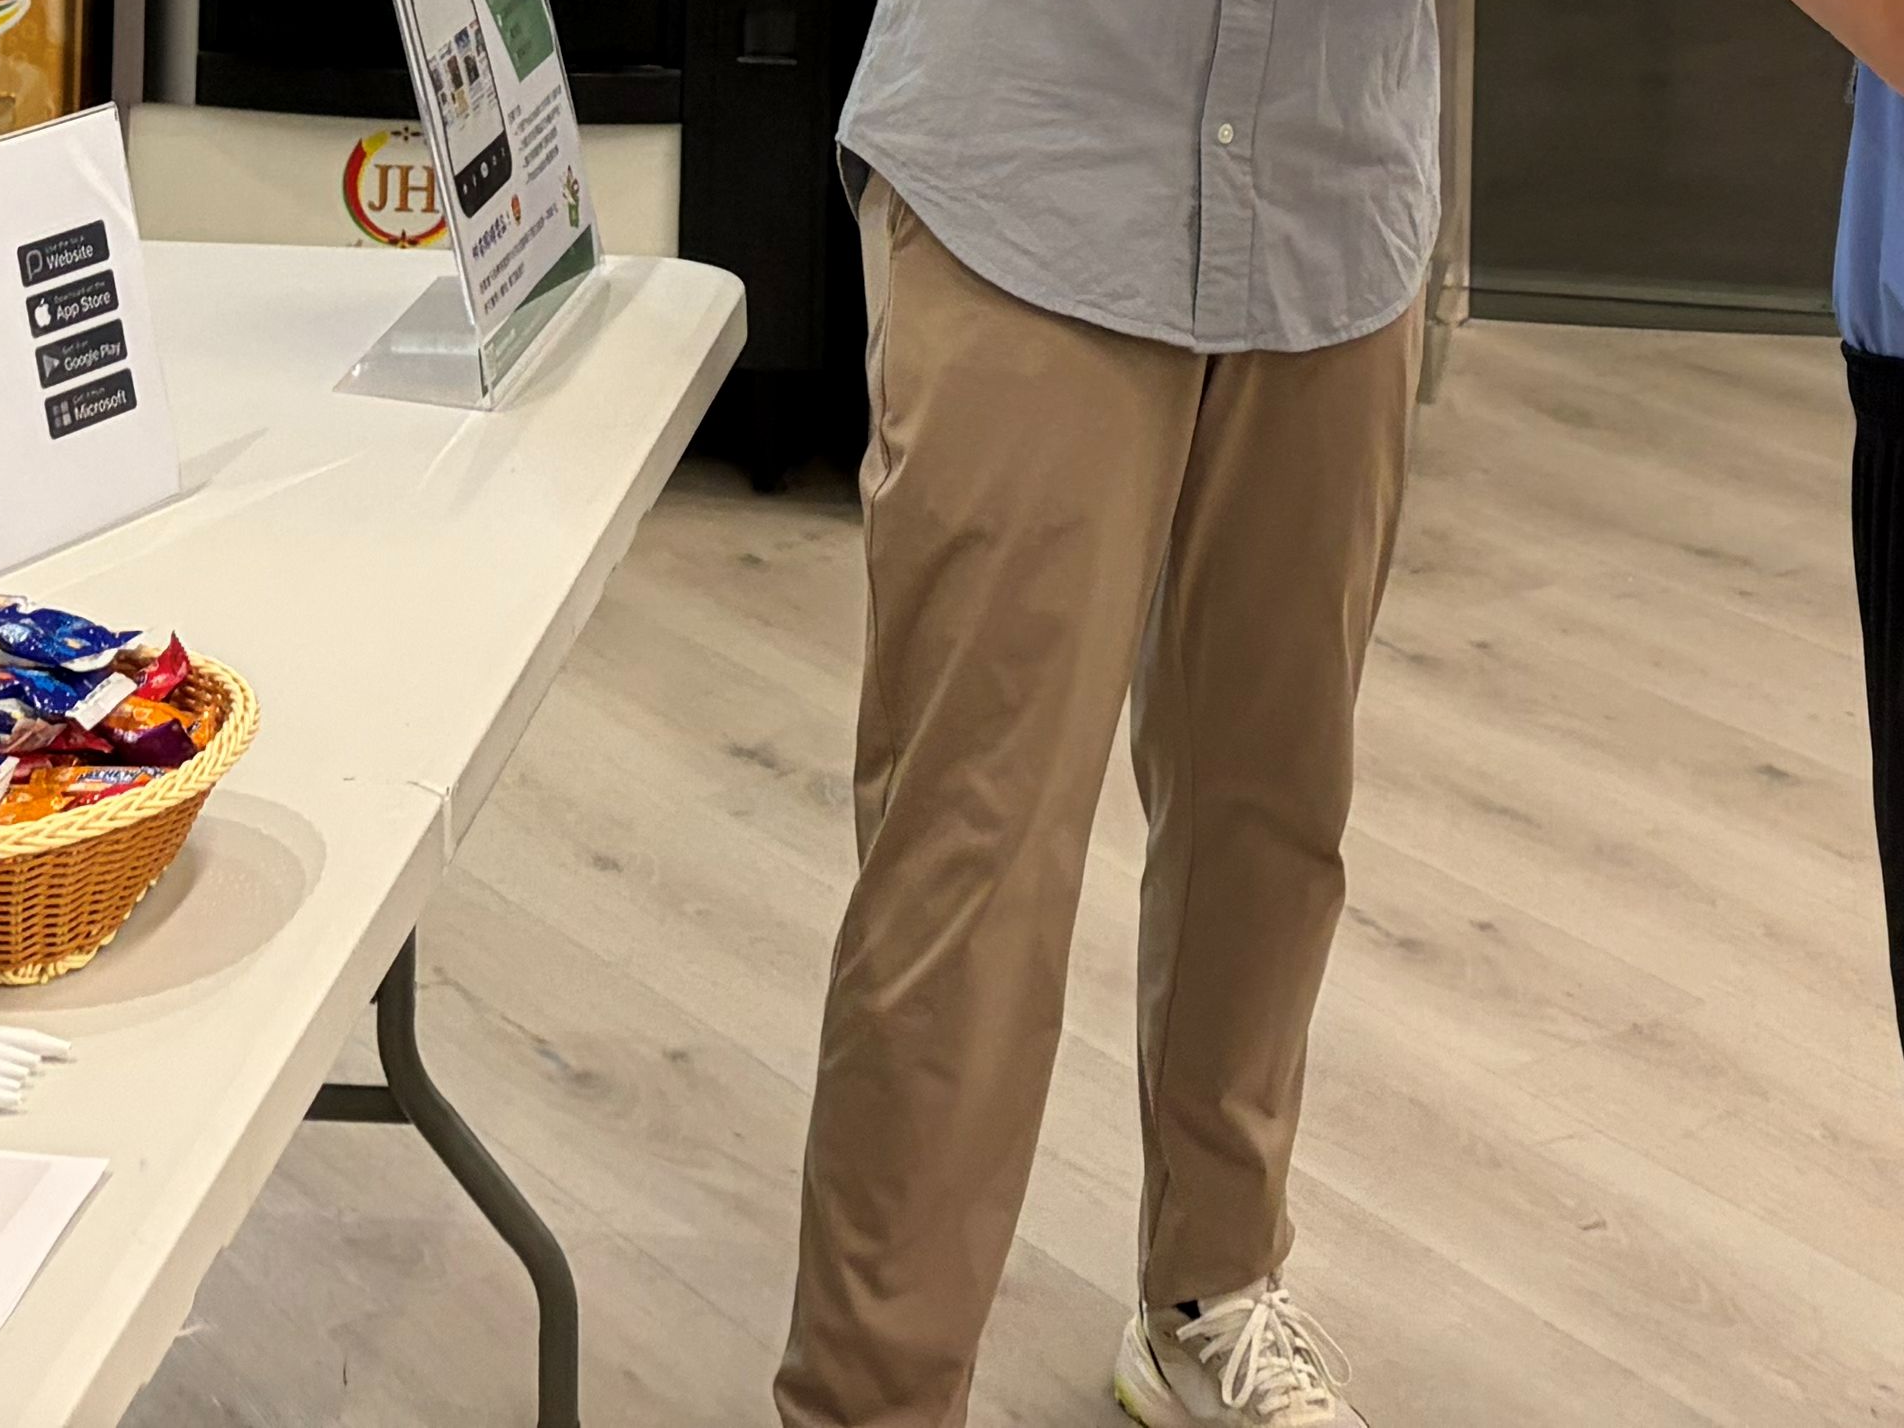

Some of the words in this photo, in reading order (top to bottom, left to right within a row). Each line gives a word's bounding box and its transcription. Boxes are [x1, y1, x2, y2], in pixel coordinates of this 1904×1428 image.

[366, 164, 441, 213] JH
[46, 244, 94, 271] Website
[56, 304, 80, 322] App
[81, 290, 112, 313] Store
[64, 348, 100, 373] Google
[100, 341, 122, 361] Play
[74, 388, 128, 422] Microsoft
